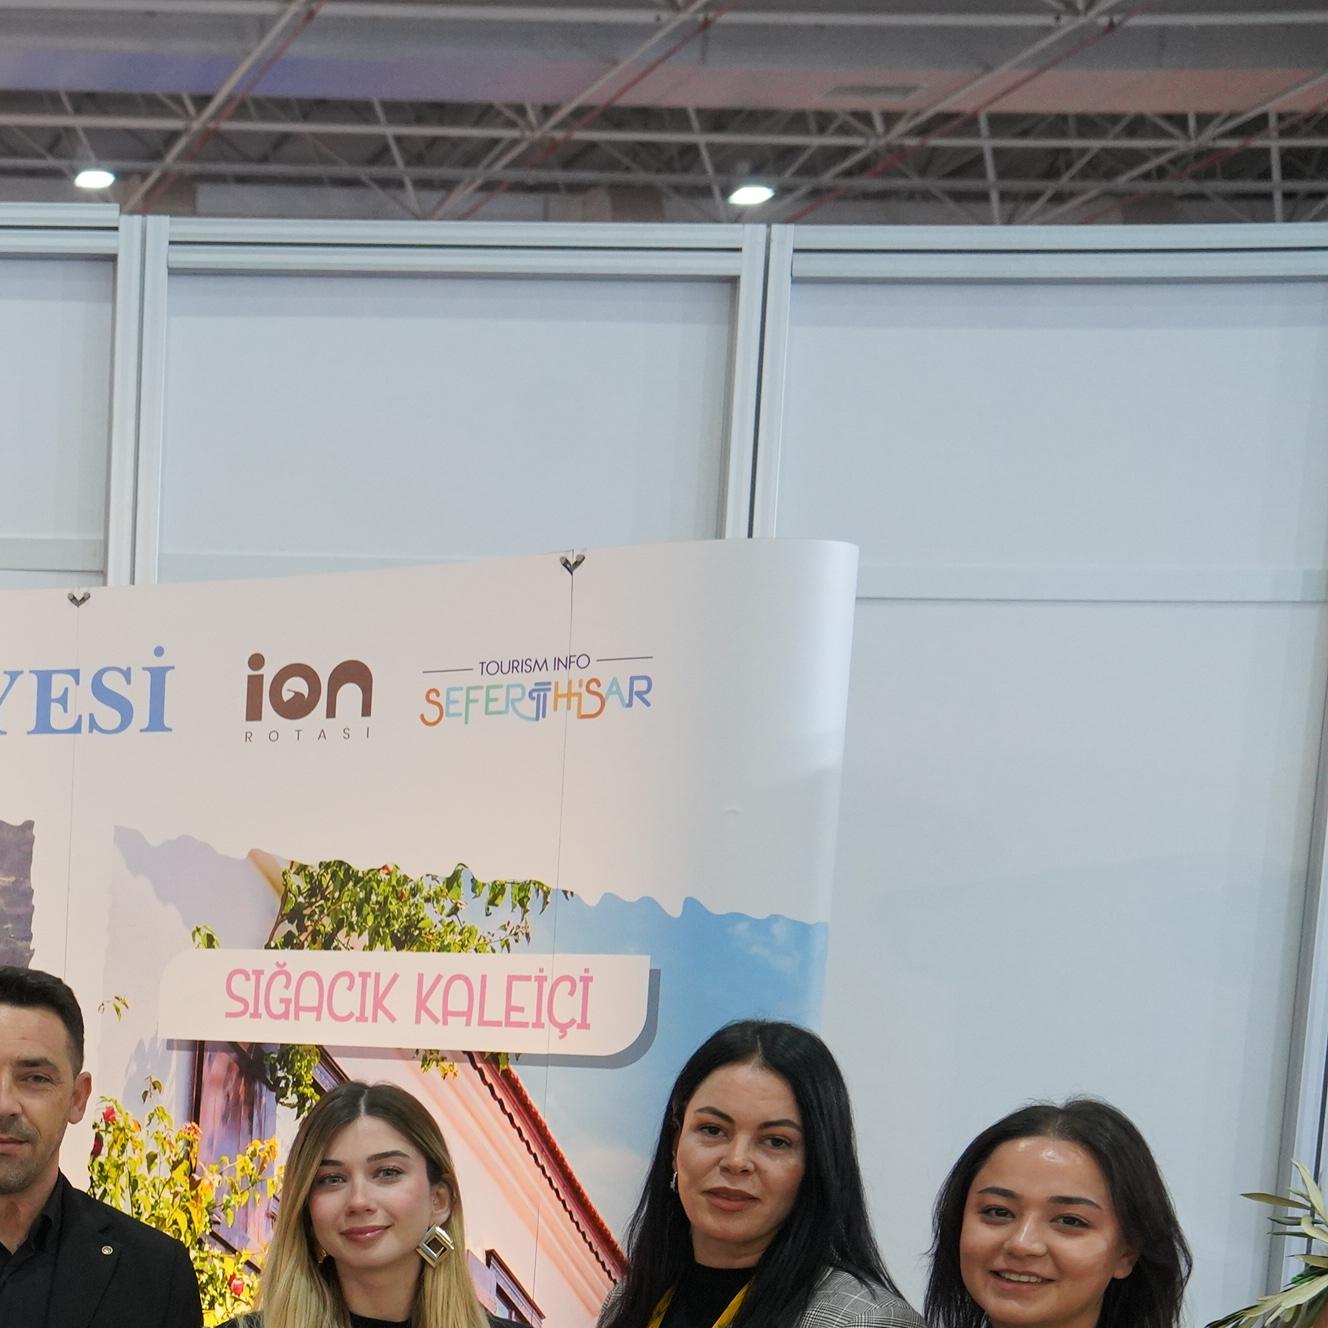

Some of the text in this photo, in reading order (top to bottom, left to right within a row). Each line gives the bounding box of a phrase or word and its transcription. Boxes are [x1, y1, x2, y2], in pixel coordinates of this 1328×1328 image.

[478, 653, 591, 676] TOURISM INFO
[244, 727, 370, 743] ROTASI
[224, 961, 594, 1040] SIĞACIK KALEİÇİ
